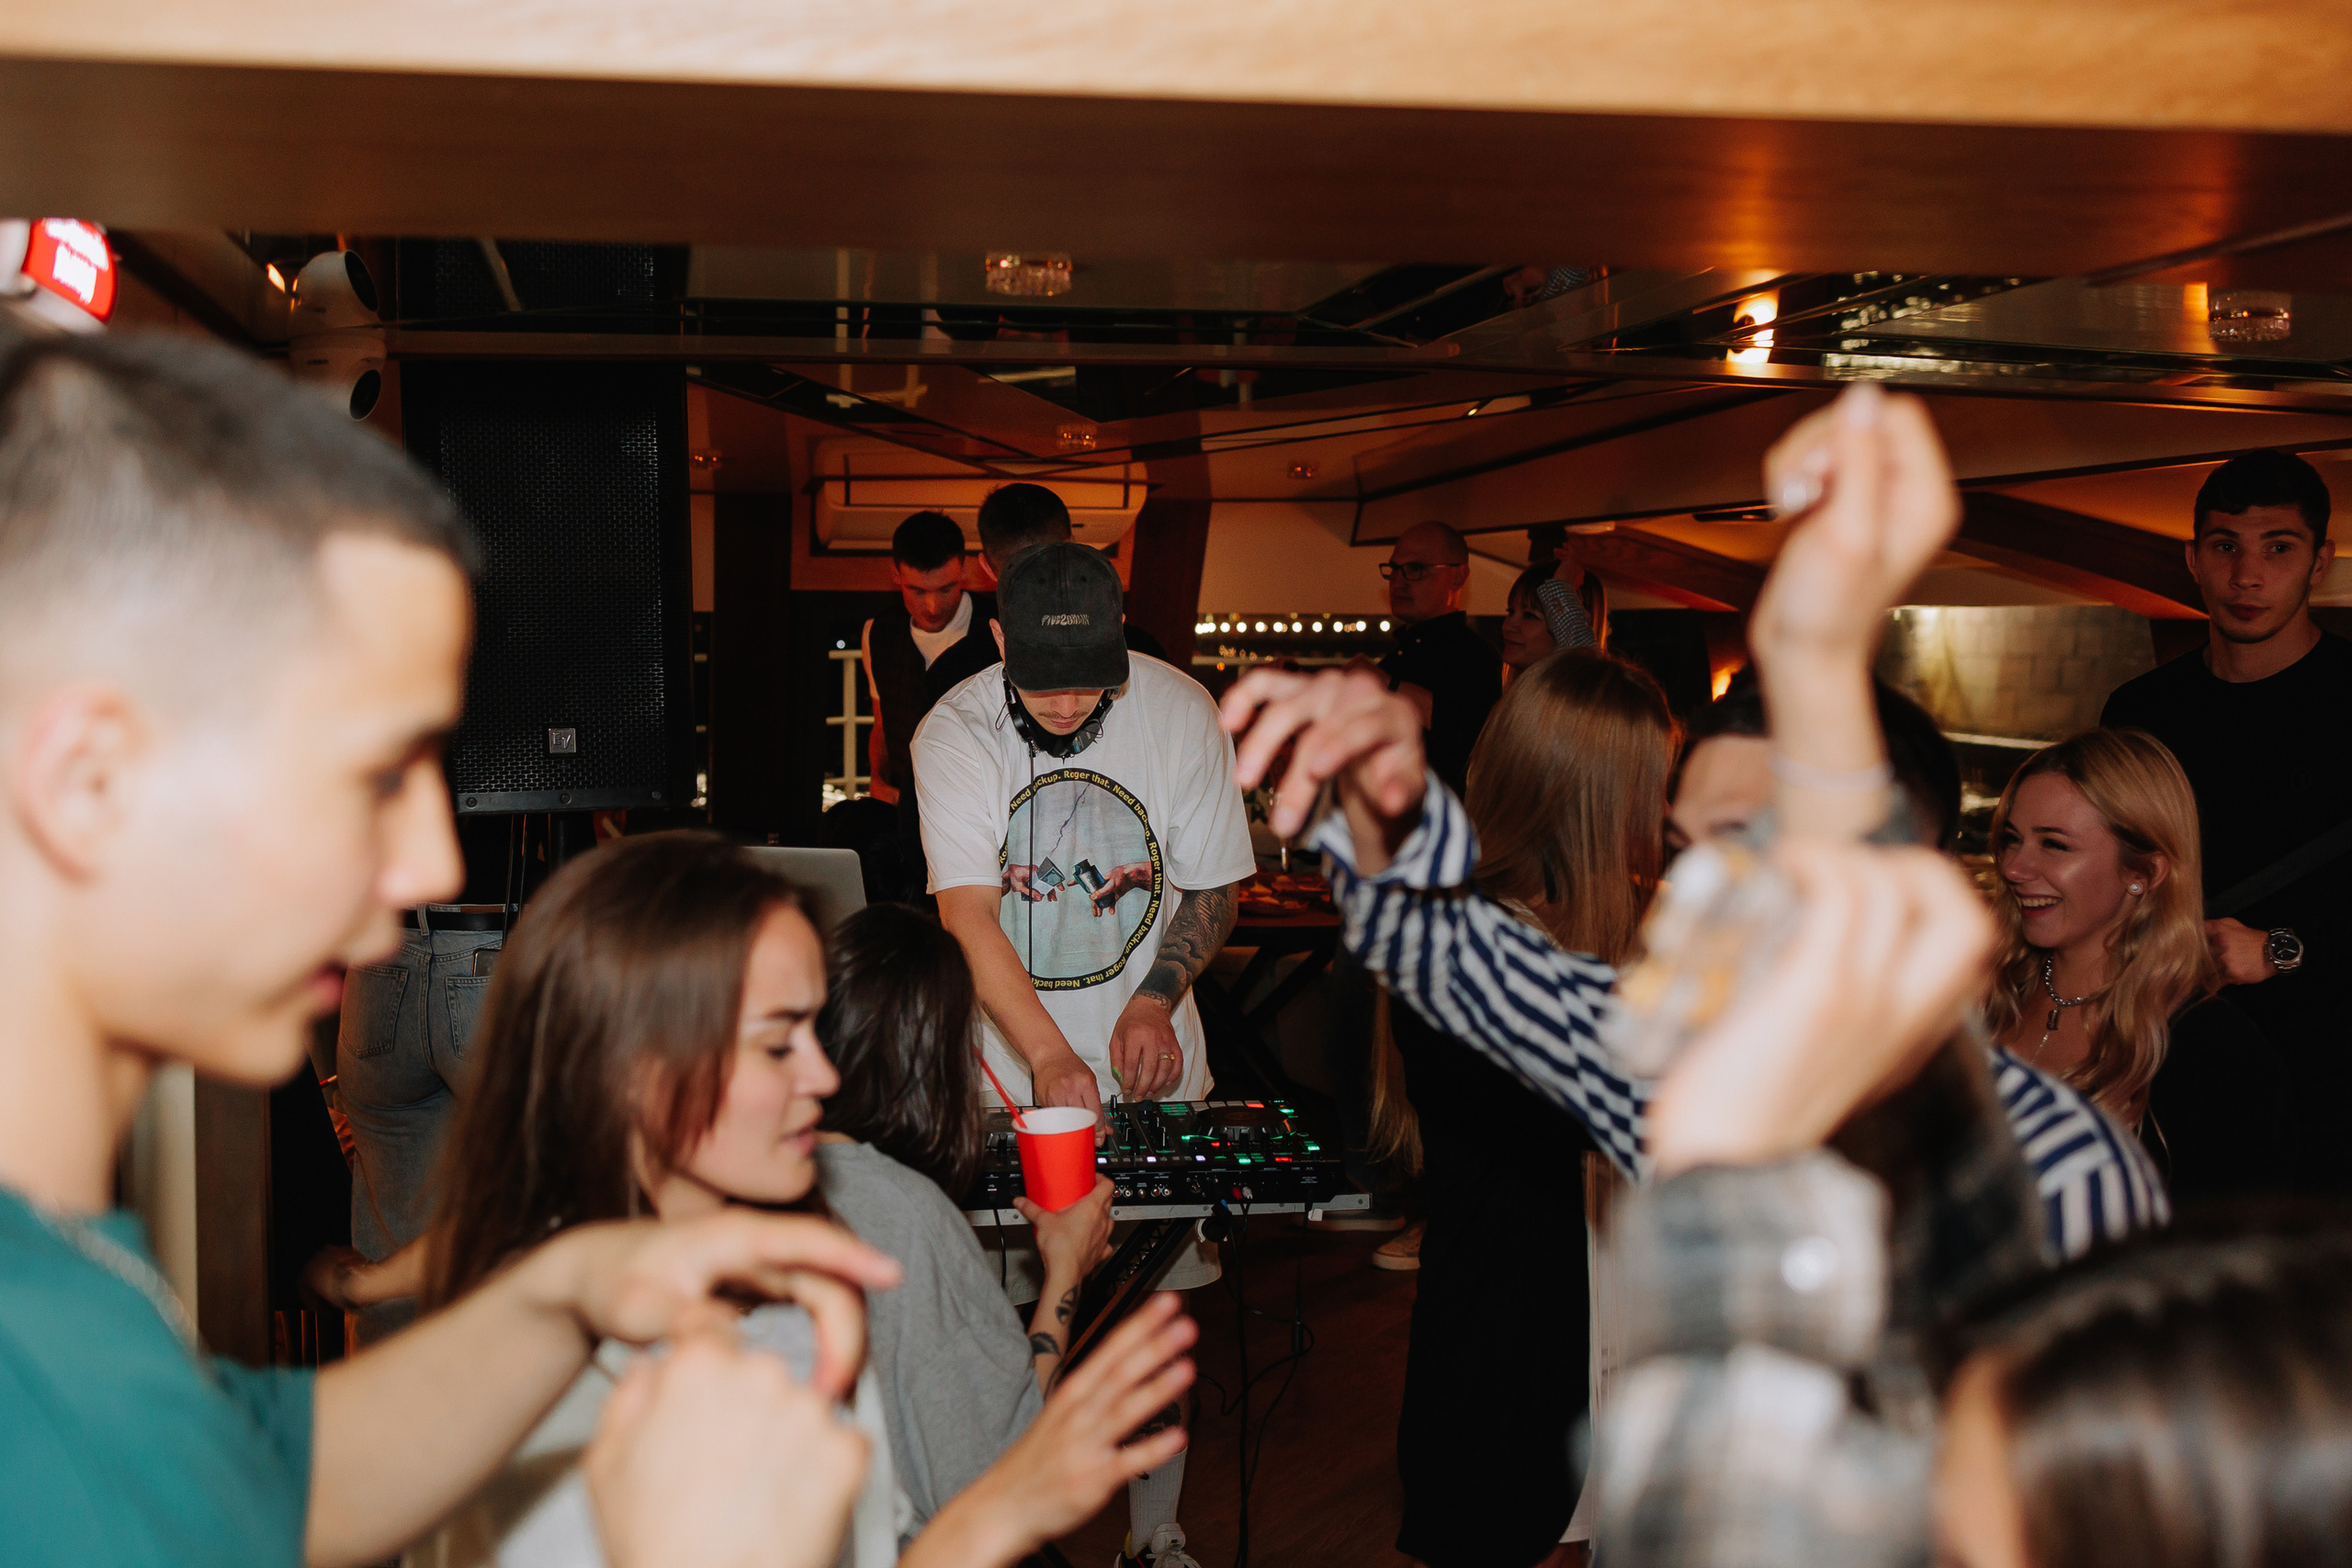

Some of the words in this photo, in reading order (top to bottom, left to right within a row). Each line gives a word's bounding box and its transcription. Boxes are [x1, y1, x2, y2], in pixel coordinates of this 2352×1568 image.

[1064, 770, 1091, 781] Roger
[1091, 774, 1111, 789] that.
[1011, 788, 1032, 810] Need
[1113, 784, 1136, 806] Need
[1148, 841, 1160, 871] Roger
[1154, 873, 1162, 897] that.
[1144, 900, 1159, 926] Need
[1125, 924, 1148, 954] backup.
[1104, 956, 1126, 977] Roger
[1054, 979, 1080, 988] Need
[1082, 973, 1104, 985] that.
